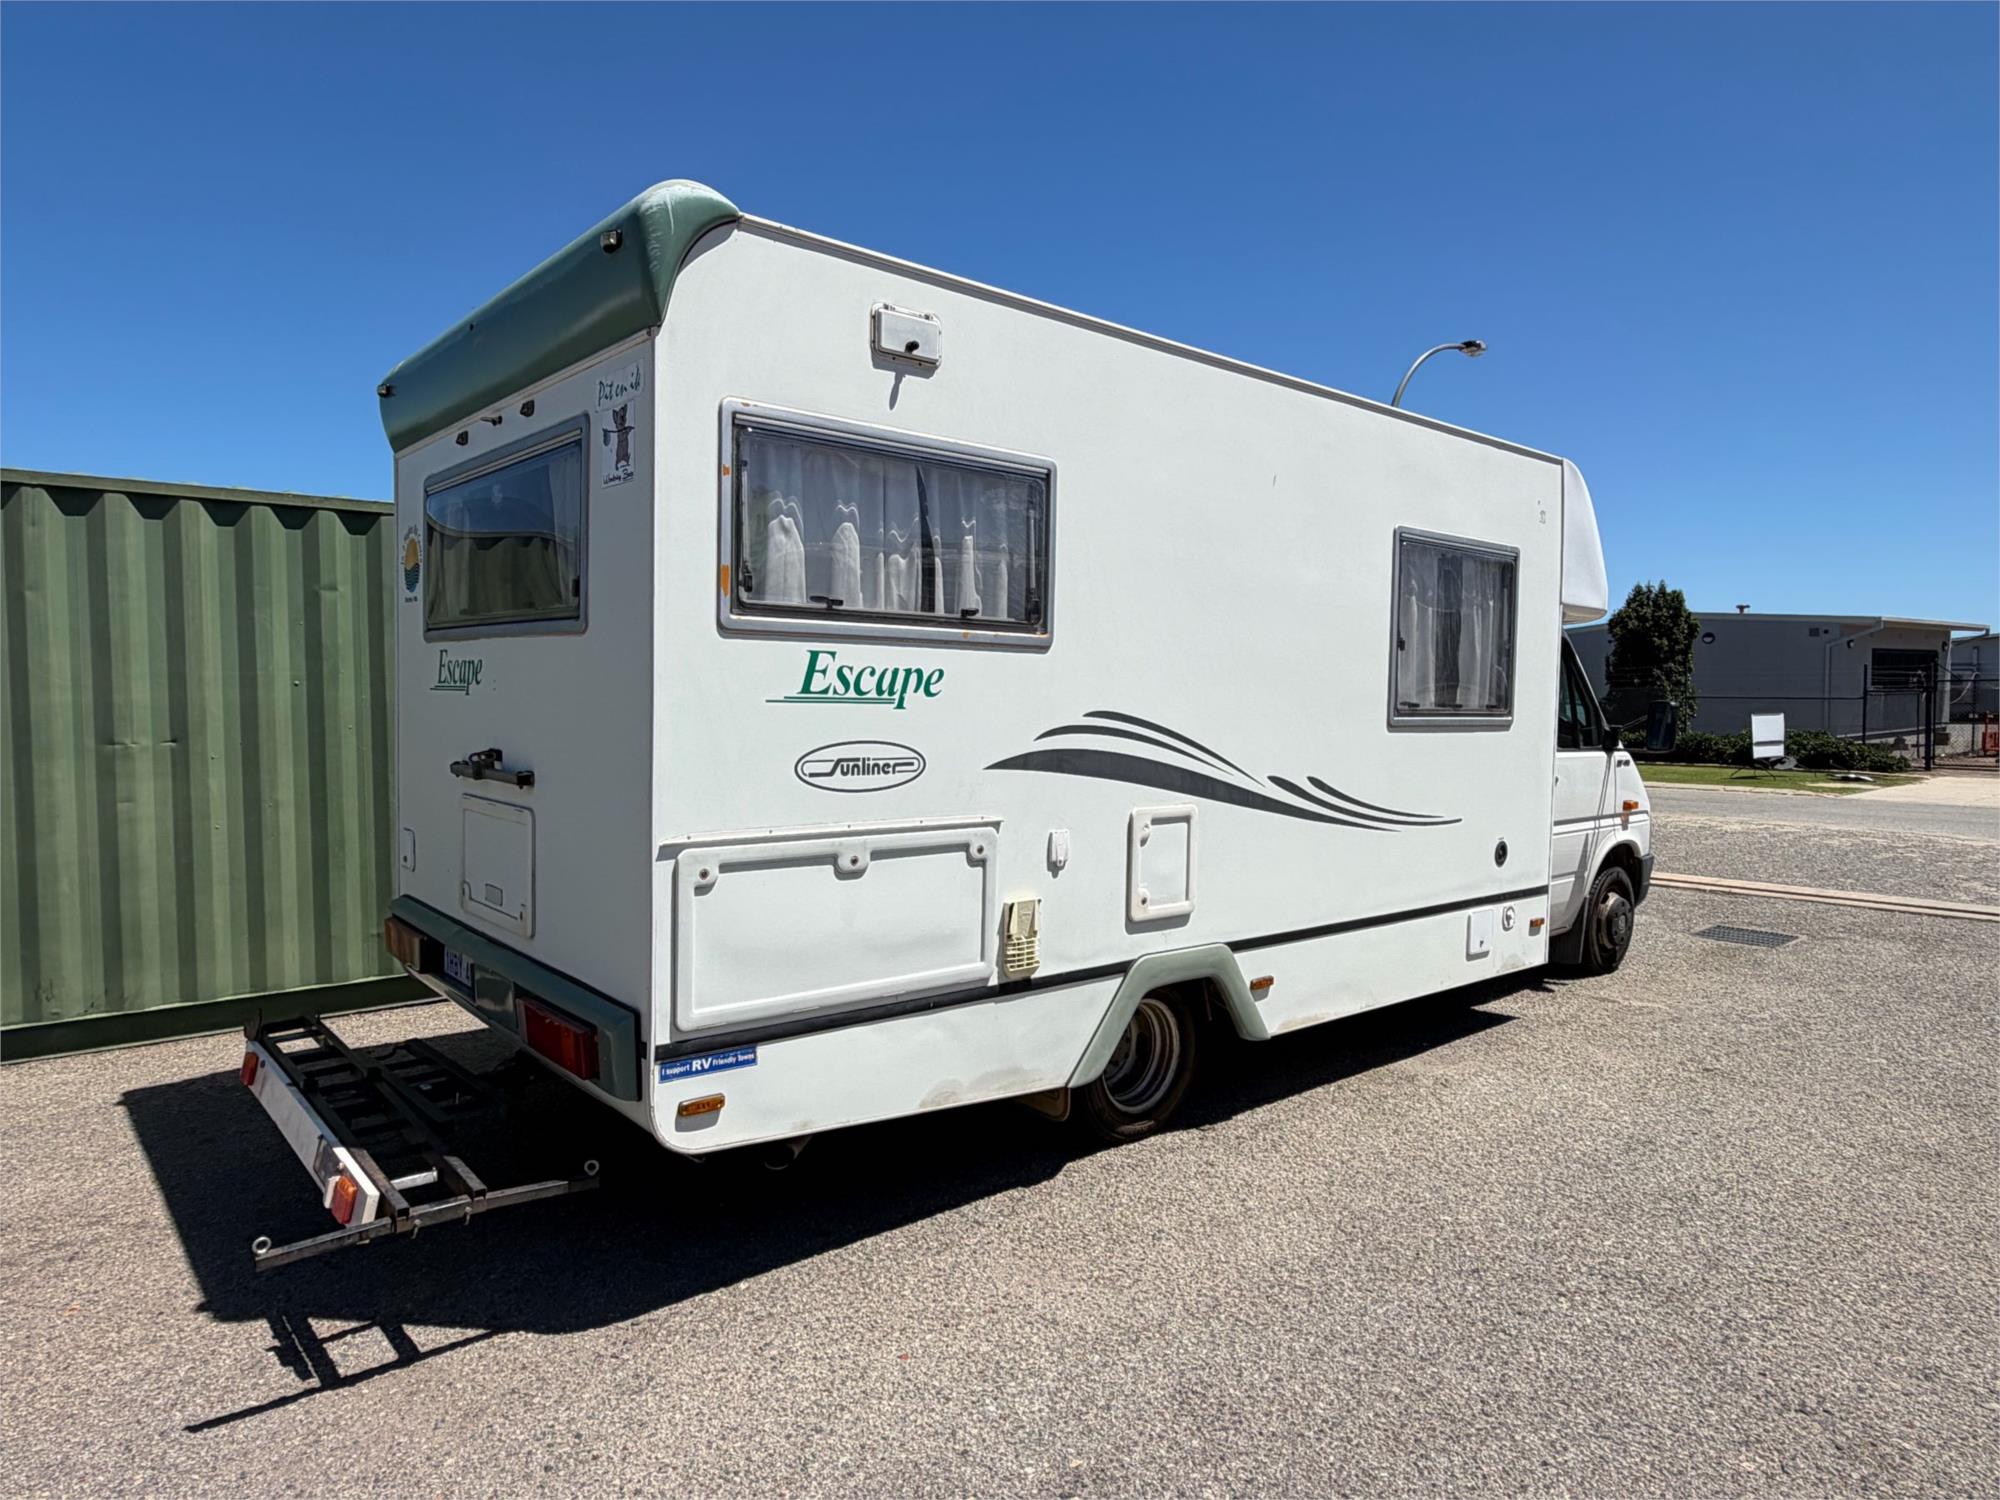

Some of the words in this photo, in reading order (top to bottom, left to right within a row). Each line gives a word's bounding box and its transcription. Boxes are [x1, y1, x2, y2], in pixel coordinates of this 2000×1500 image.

[438, 649, 483, 696] Escape
[797, 650, 945, 710] Escape
[808, 757, 915, 778] Sunliner
[661, 1068, 665, 1076] I
[666, 1064, 690, 1076] support
[692, 1057, 713, 1072] RV
[712, 1055, 737, 1067] Friendly
